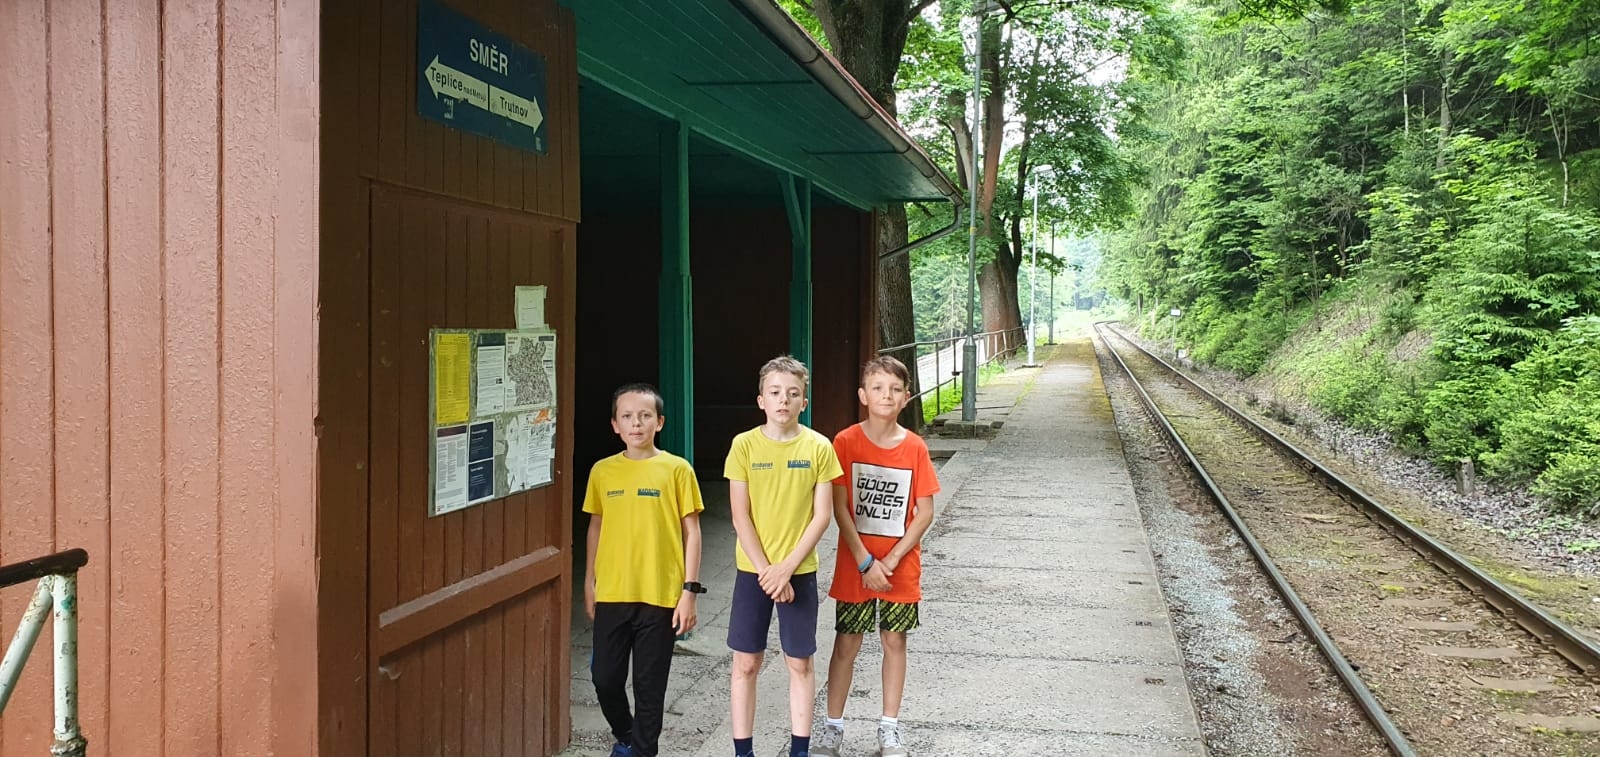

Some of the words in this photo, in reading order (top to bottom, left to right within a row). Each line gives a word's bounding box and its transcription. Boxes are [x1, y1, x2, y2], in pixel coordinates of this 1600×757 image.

[469, 38, 508, 76] SMĚR
[430, 66, 463, 91] Teplice
[500, 96, 529, 118] Trutnov
[856, 477, 899, 494] GOOD
[858, 491, 905, 508] VIBES
[855, 504, 892, 520] ONLY
